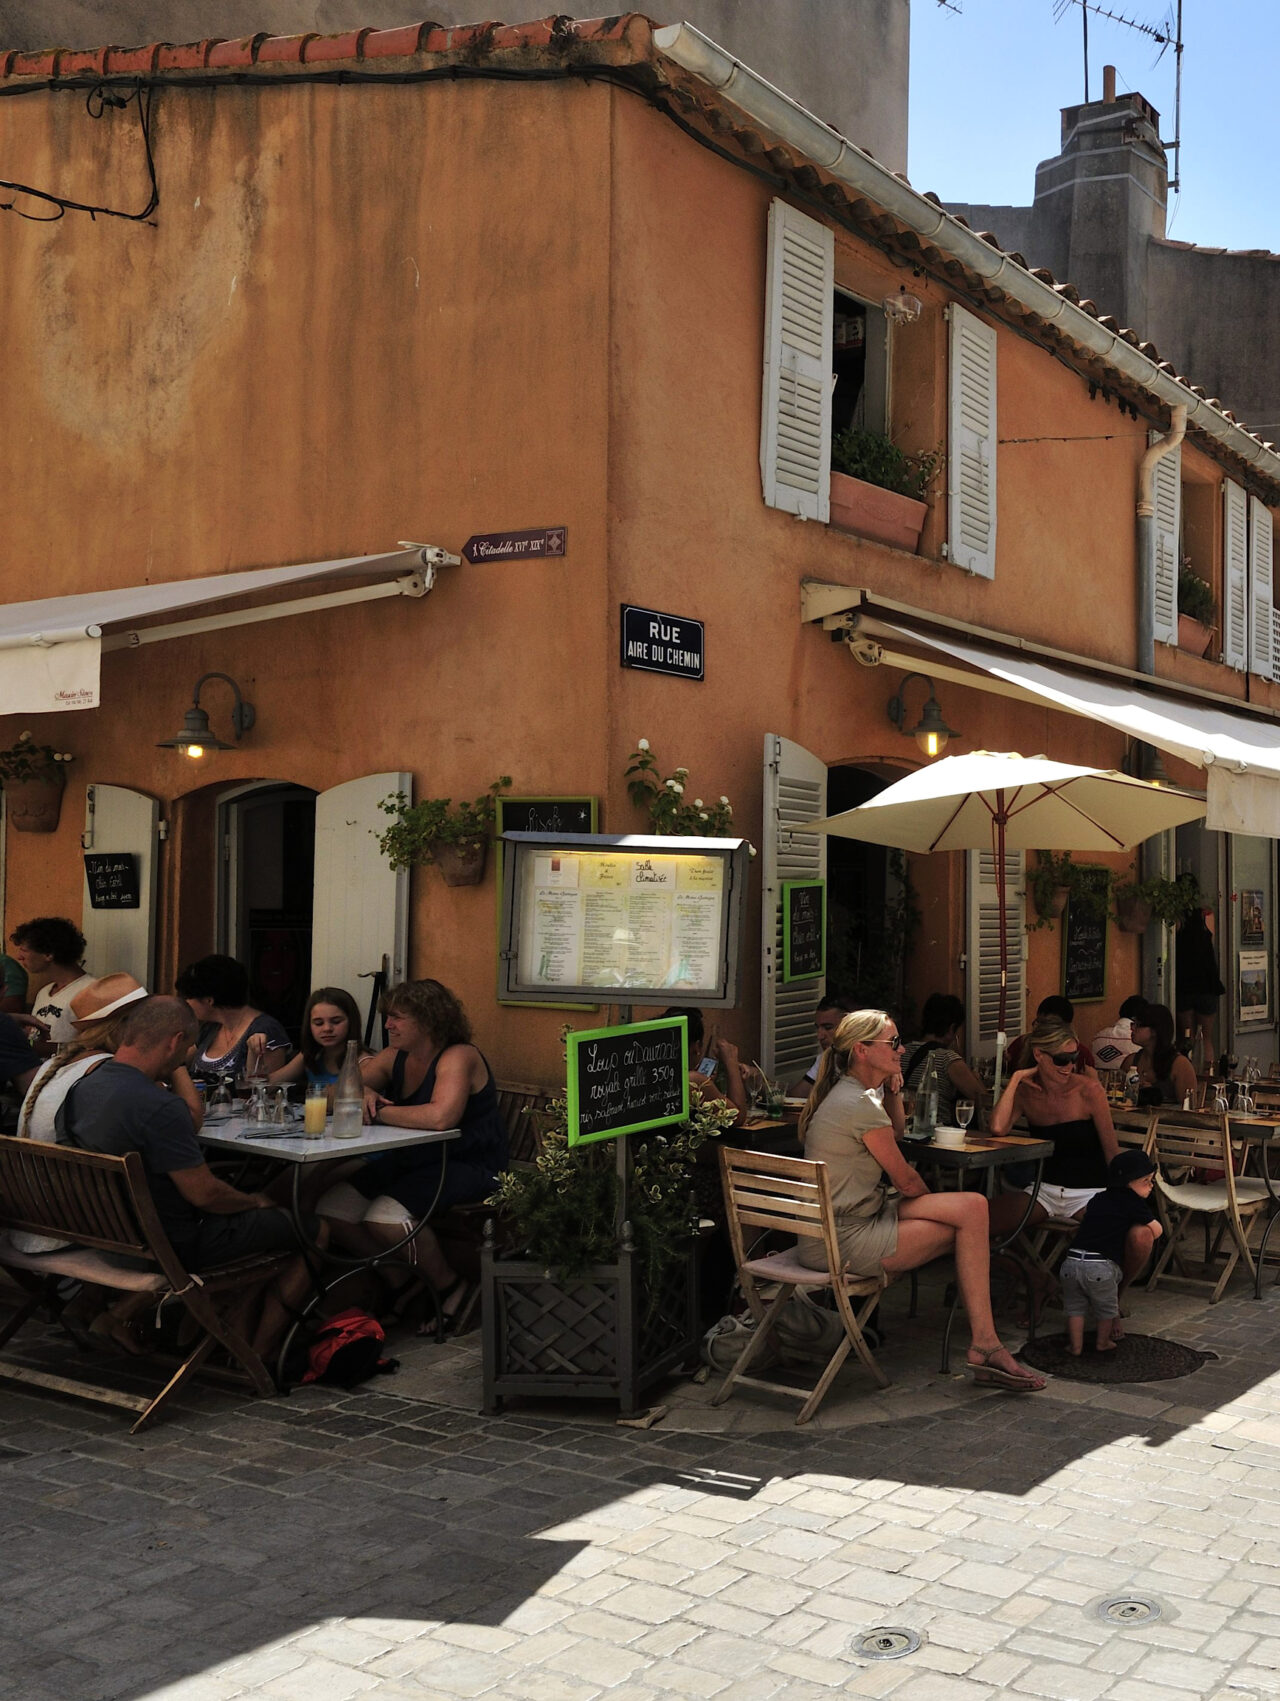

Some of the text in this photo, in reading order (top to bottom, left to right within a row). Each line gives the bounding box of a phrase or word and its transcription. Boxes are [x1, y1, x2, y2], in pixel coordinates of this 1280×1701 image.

[479, 541, 513, 557] Citadelle
[649, 621, 681, 643] RUE
[627, 640, 700, 670] AIRE DU CHEMIN
[587, 1043, 619, 1080] Loup
